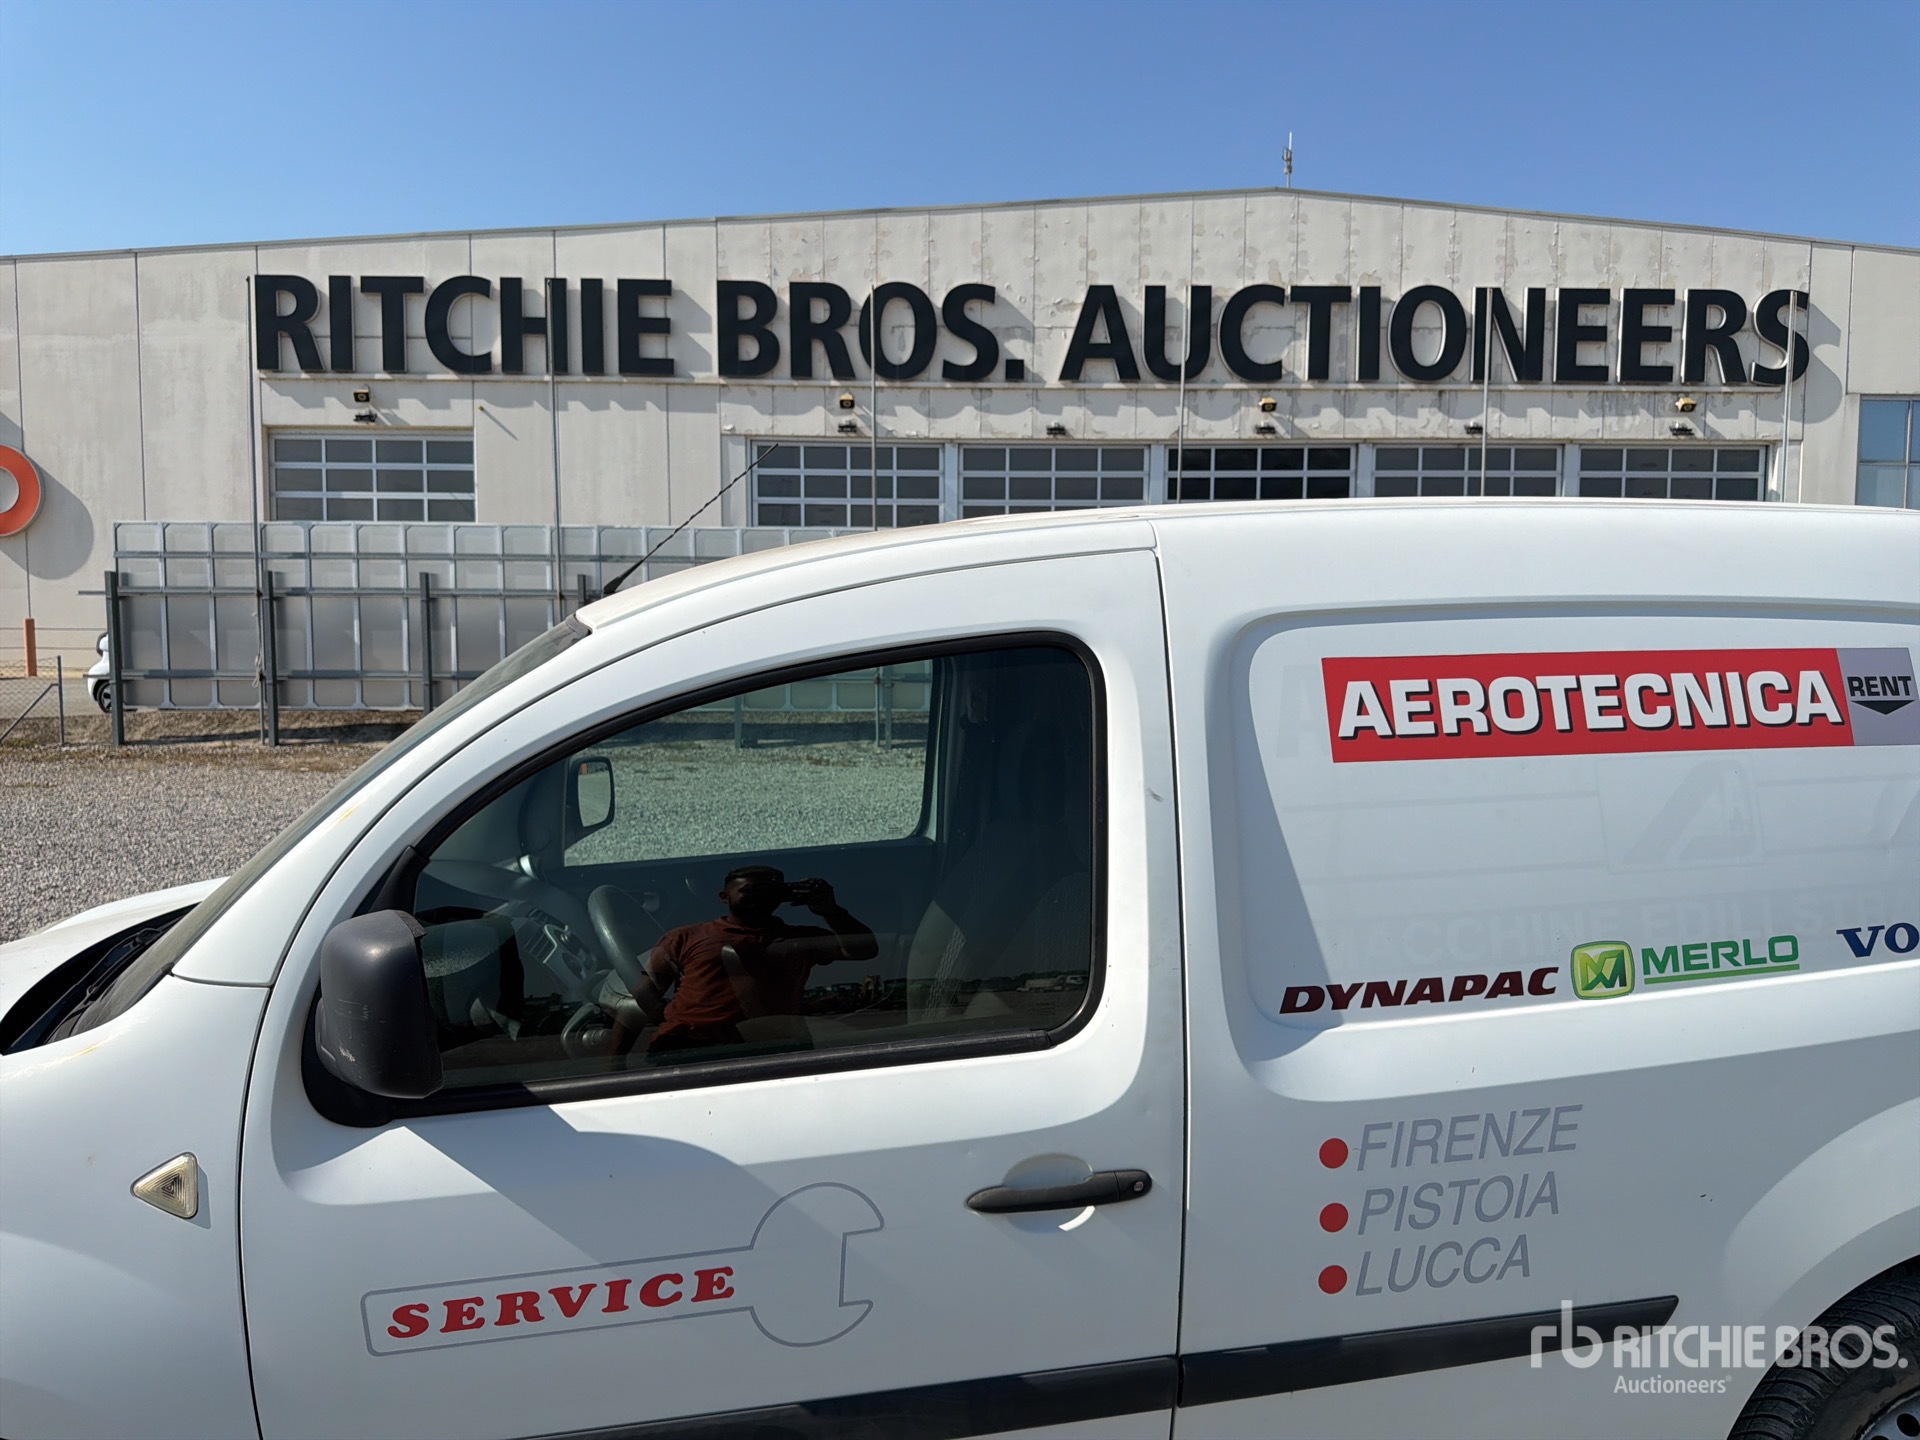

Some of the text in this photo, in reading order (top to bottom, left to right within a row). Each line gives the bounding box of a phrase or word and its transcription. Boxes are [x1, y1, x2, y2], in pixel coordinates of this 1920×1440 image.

[254, 275, 1811, 385] RITCHIE BROS. AUCTIONEERS
[1337, 670, 1846, 738] AEROTECNICA
[1846, 676, 1912, 697] RENT
[1641, 935, 1800, 976] MERLO
[1836, 923, 1920, 959] VO
[1279, 967, 1560, 1015] DYNAPAC
[1356, 1104, 1584, 1172] FIRENZE
[1357, 1171, 1560, 1236] PISTOIA
[1355, 1234, 1531, 1297] LUCCA
[387, 1266, 736, 1339] SERVICE
